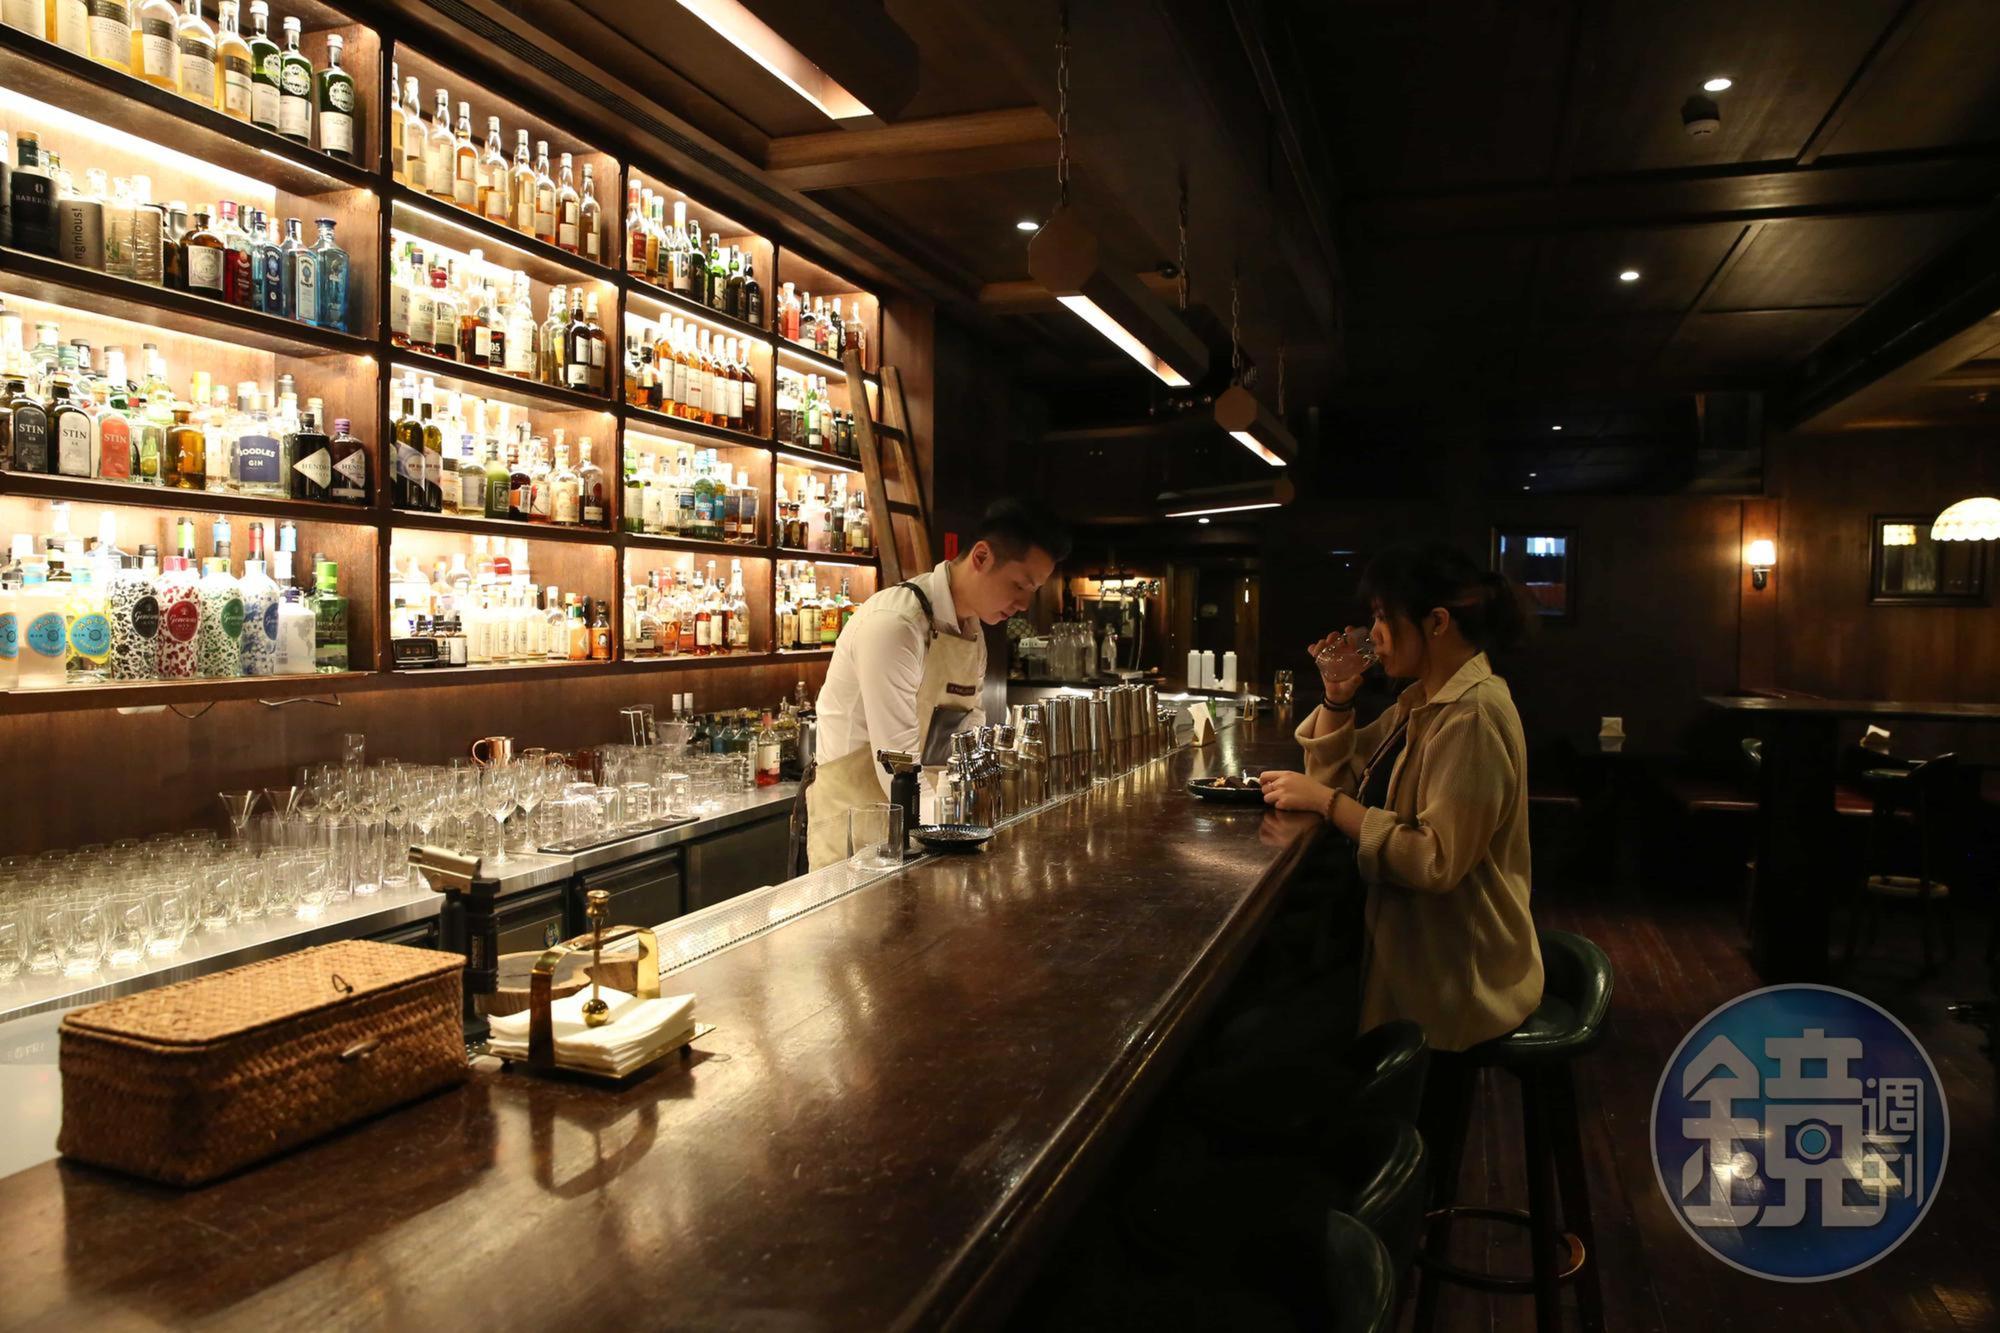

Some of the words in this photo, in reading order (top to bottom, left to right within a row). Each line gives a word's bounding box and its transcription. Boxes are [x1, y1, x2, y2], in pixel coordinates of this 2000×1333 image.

[71, 208, 86, 260] nginious!
[19, 423, 45, 435] STIN
[63, 429, 88, 439] STIN
[103, 433, 127, 444] STIN
[248, 459, 264, 467] GIN
